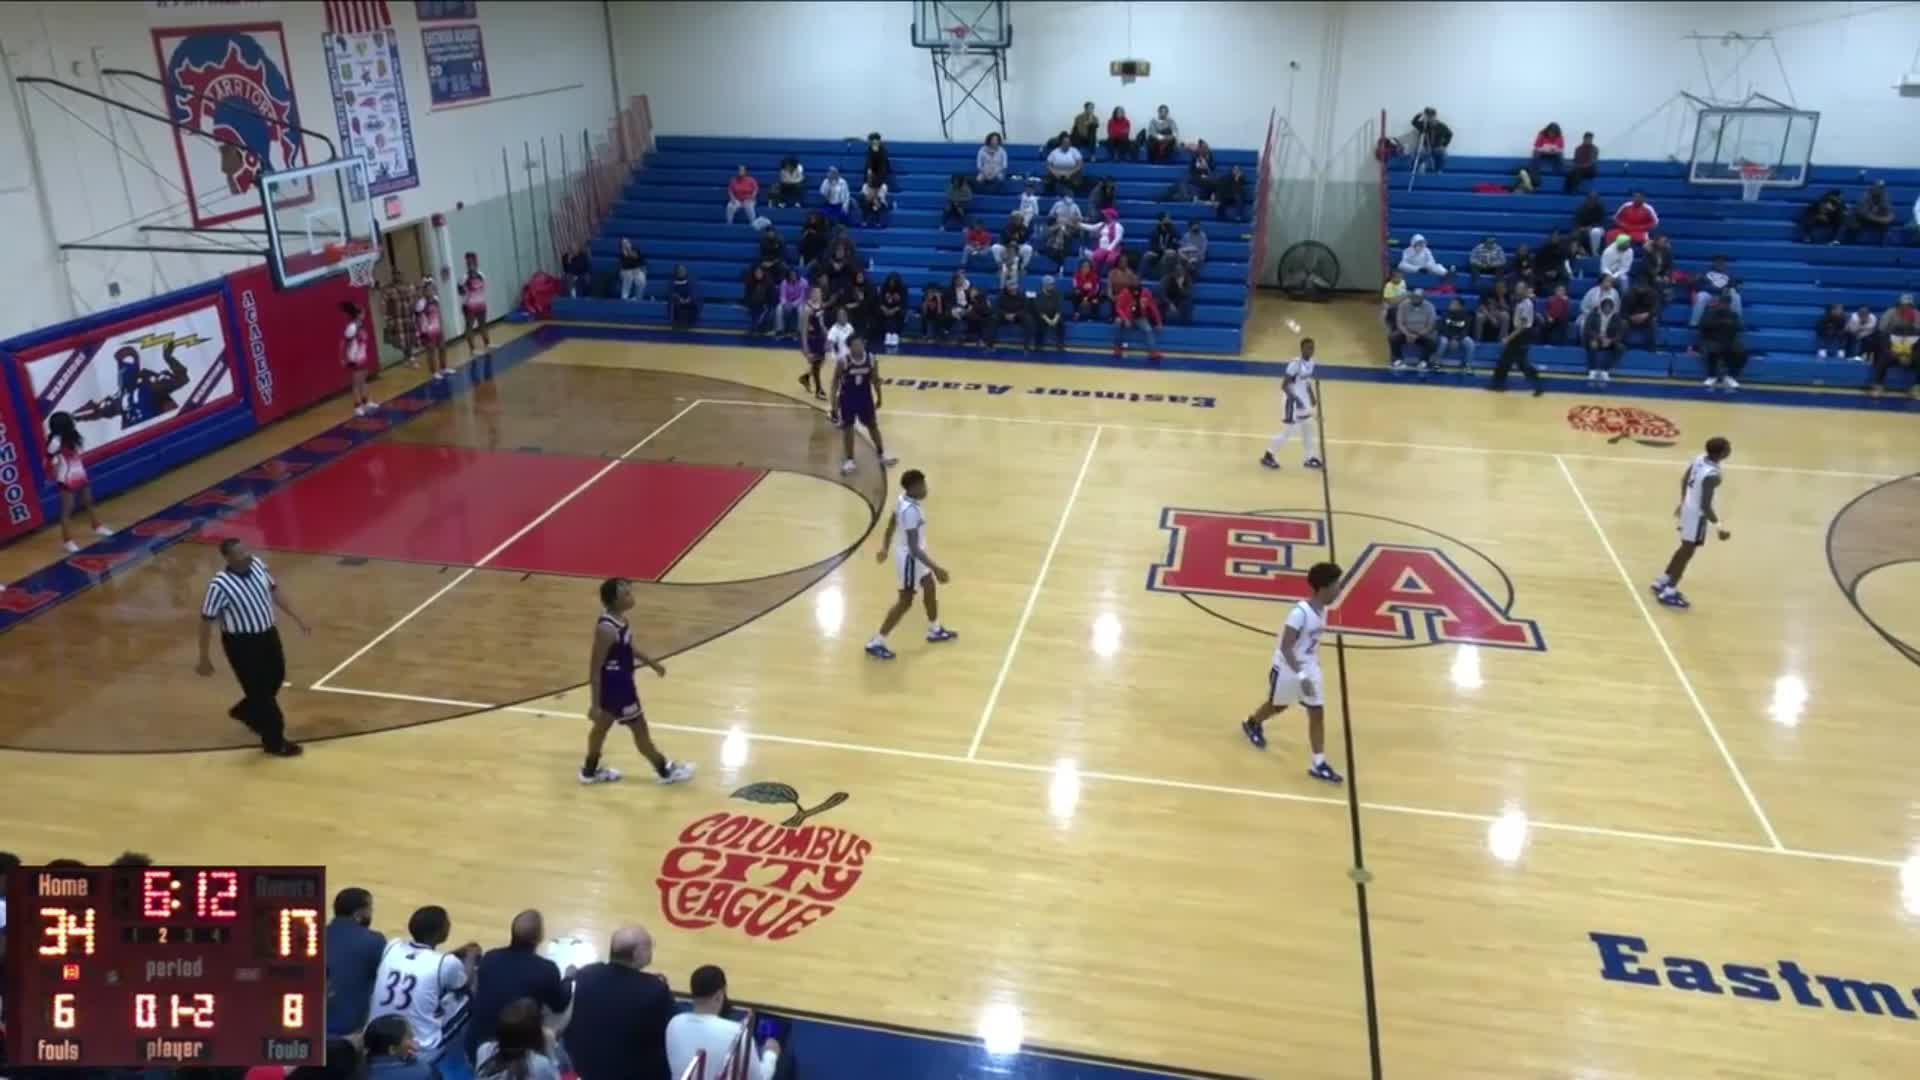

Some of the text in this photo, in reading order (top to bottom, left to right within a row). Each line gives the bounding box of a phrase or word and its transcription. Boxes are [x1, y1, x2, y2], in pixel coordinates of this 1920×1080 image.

[880, 377, 1013, 396] Acade
[1026, 387, 1217, 409] Eastmoor
[1146, 507, 1547, 652] EA
[678, 812, 873, 867] COLUMBUS
[661, 846, 863, 902] CITY
[656, 877, 835, 941] LEAGUE
[380, 971, 417, 1010] 33
